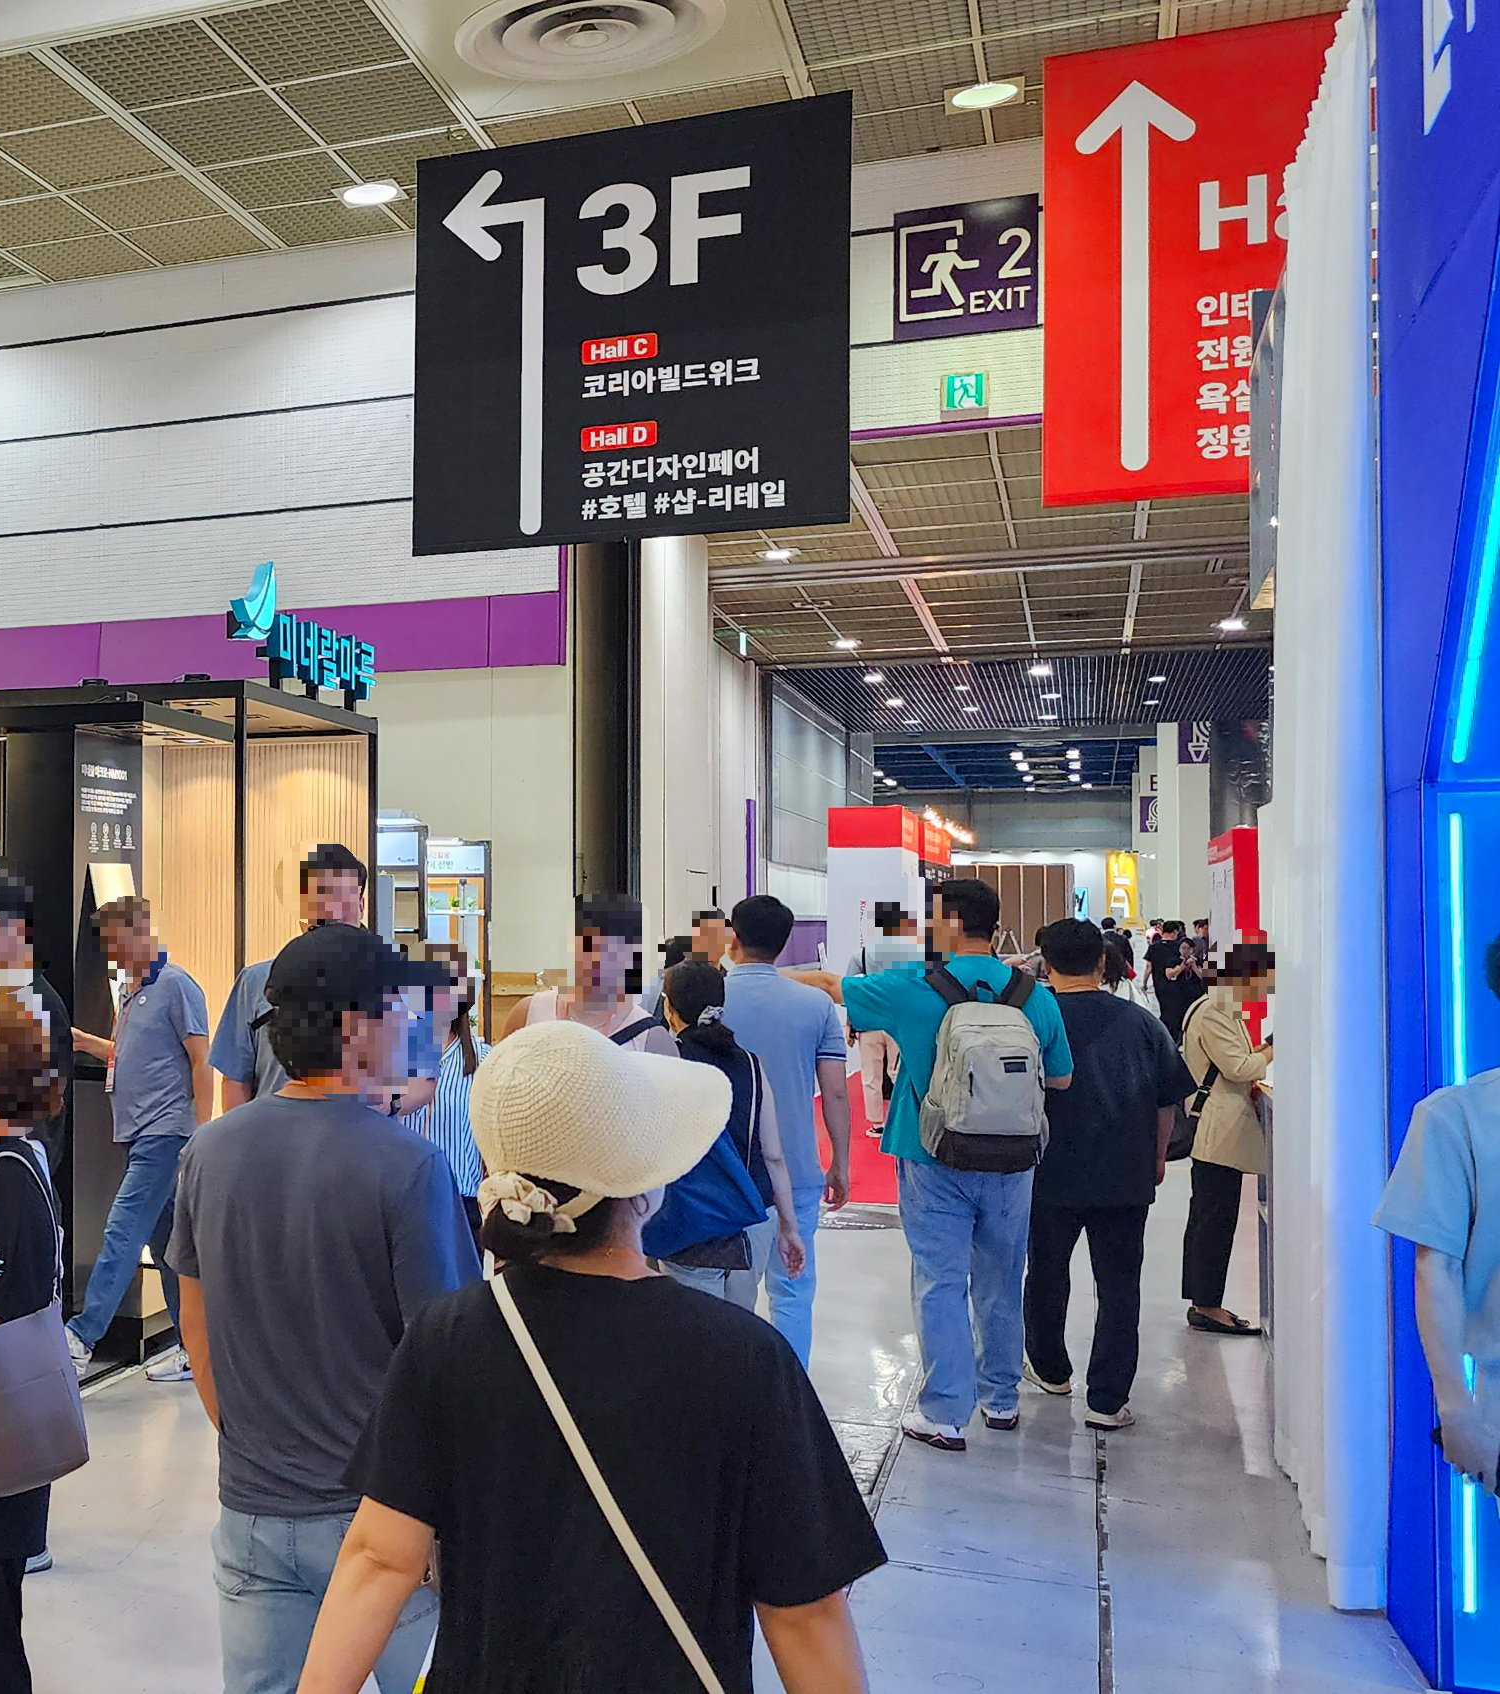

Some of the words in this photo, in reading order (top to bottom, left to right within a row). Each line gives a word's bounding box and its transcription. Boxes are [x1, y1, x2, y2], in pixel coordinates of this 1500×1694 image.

[577, 166, 751, 295] 3F
[997, 227, 1032, 280] 2
[968, 285, 1032, 314] EXIT
[590, 339, 628, 361] Hall
[633, 337, 648, 356] C
[581, 358, 761, 398] 코리아빌드위크
[590, 427, 628, 449] Hall
[633, 426, 648, 444] D
[581, 447, 760, 488] 공간디자인페어
[581, 489, 648, 521] #호텔
[653, 480, 786, 516] #샵-리테일
[270, 613, 377, 701] 미네랄마루
